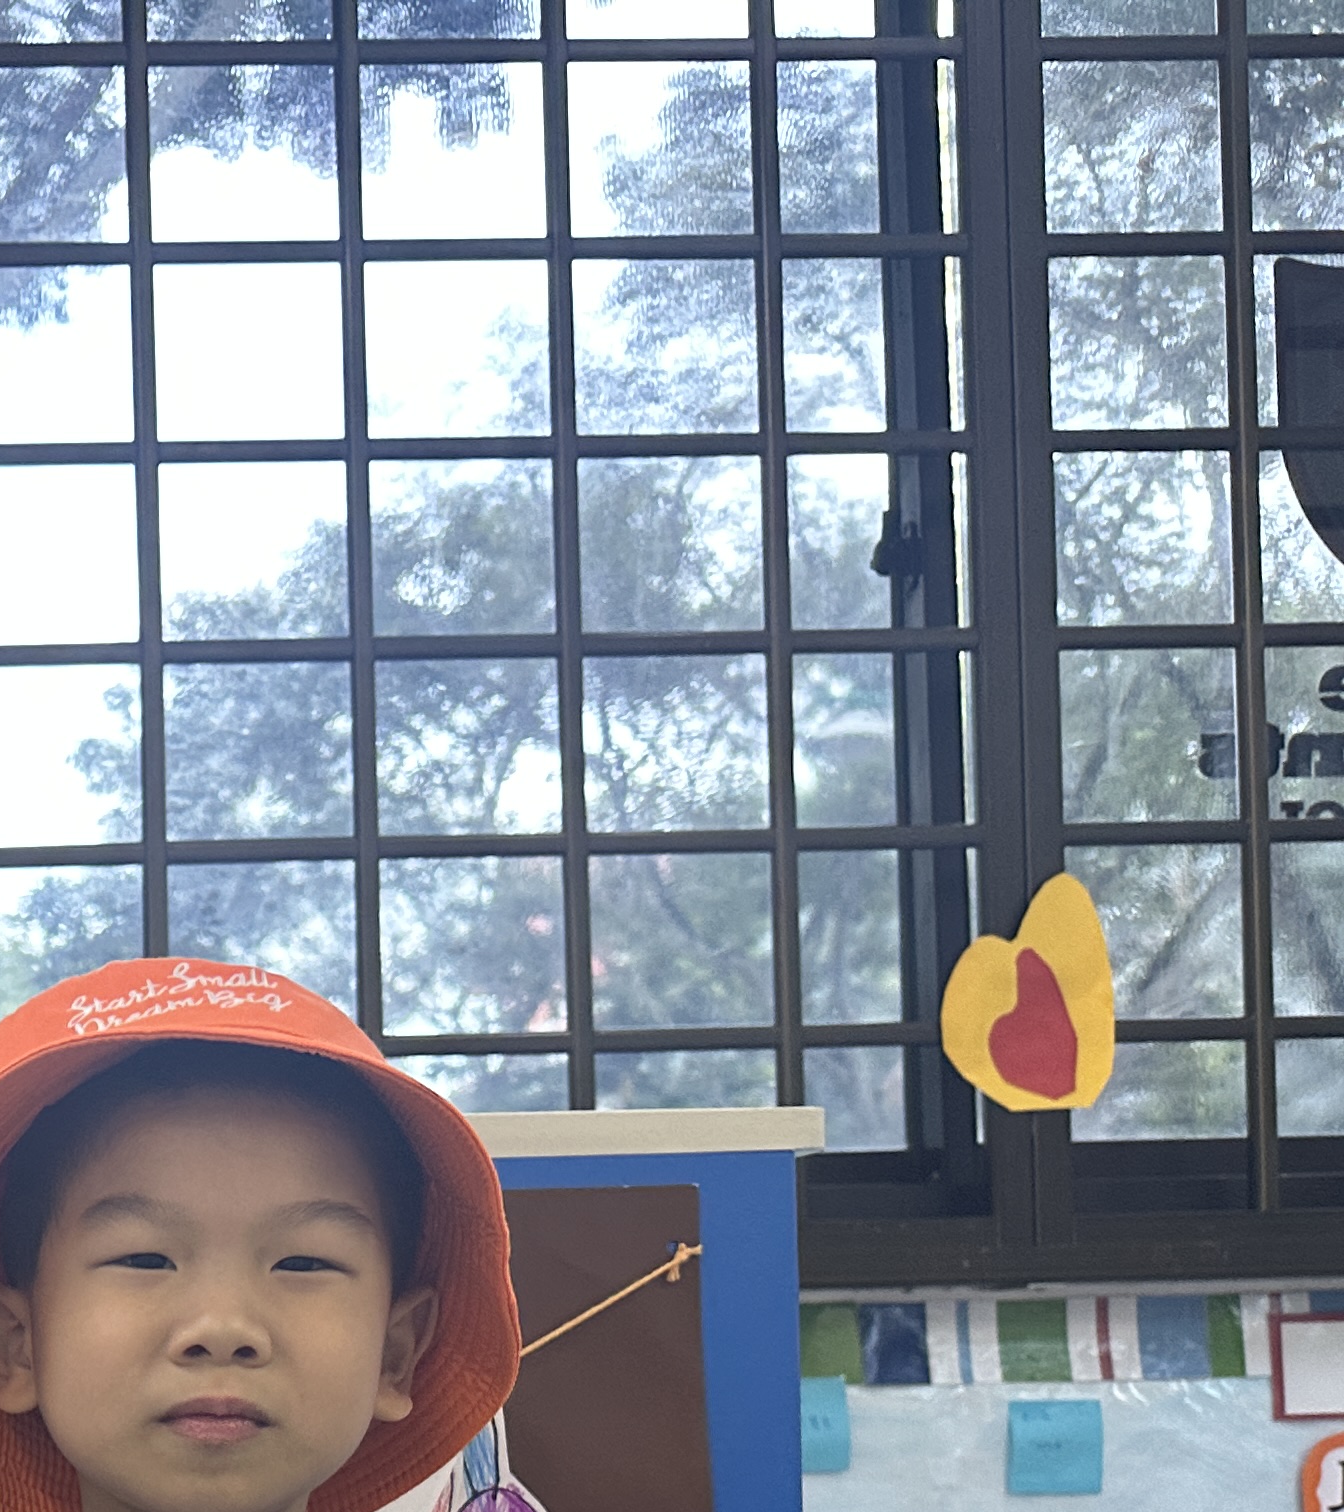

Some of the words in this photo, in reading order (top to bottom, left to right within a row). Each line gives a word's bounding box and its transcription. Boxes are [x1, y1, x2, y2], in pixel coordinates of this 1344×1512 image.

[67, 979, 168, 1028] Start
[167, 962, 278, 995] Small
[74, 996, 204, 1035] Dream
[204, 989, 293, 1012] Big
